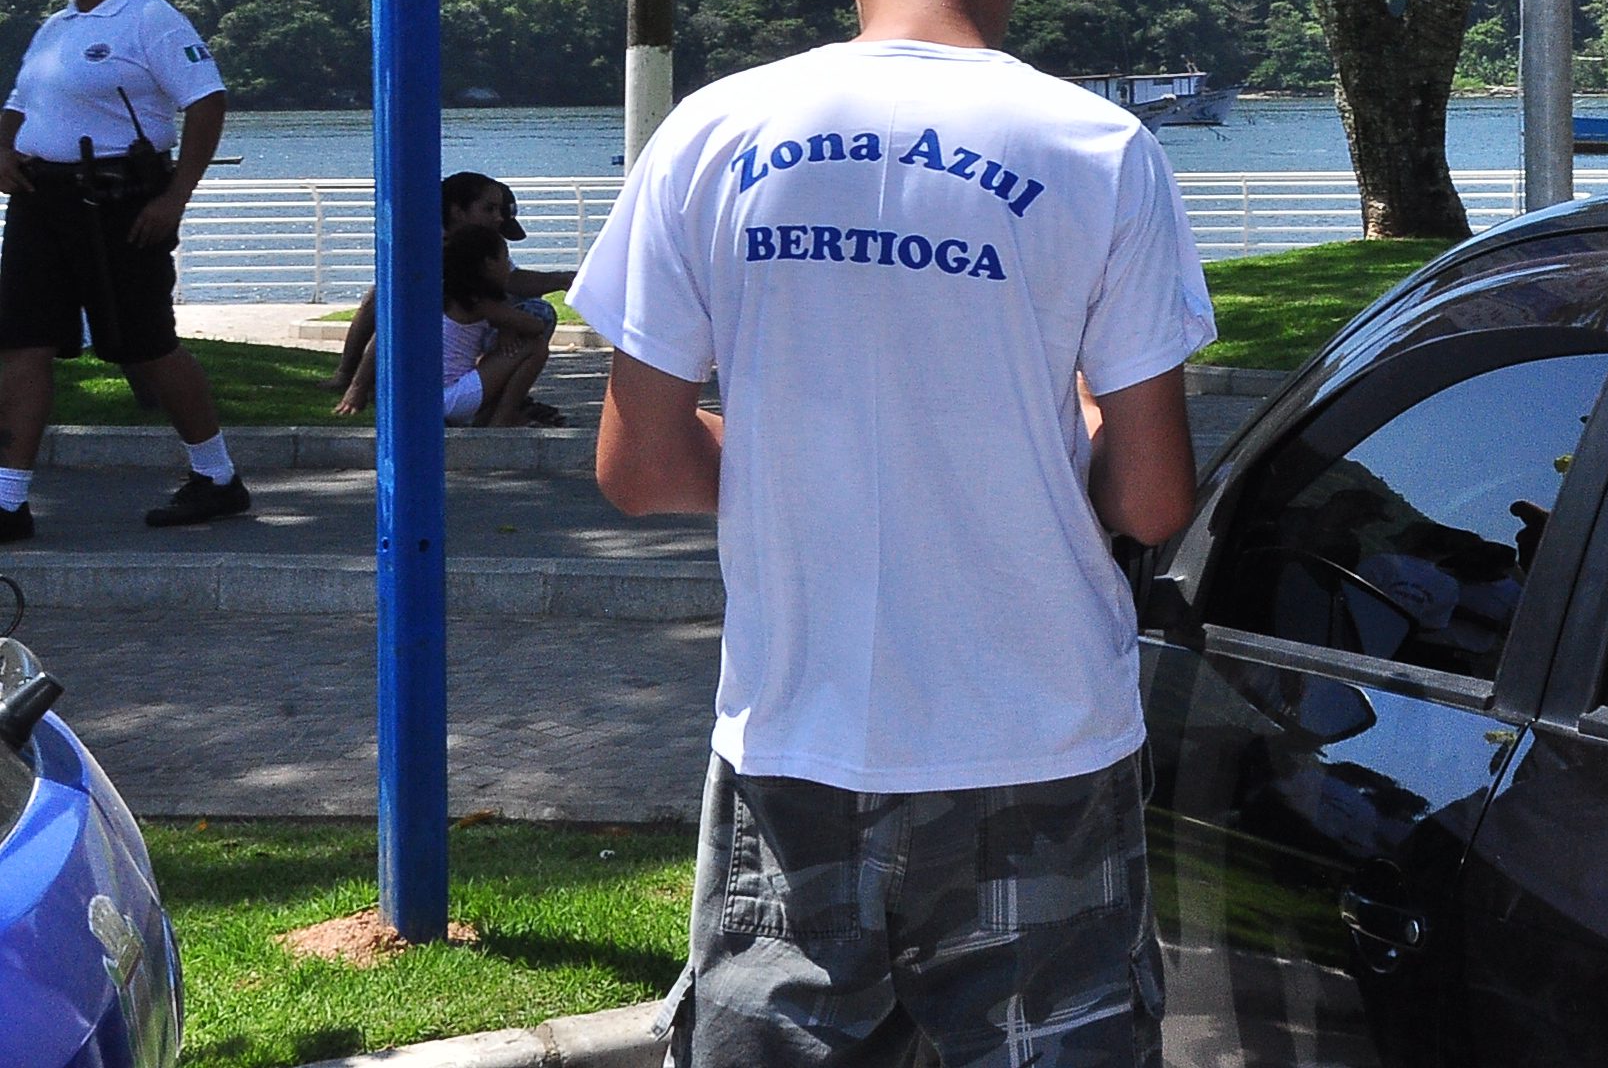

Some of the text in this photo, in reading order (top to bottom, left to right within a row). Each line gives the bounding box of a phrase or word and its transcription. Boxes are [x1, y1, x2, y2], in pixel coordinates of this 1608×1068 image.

[731, 128, 1045, 218] Zona Azul
[744, 224, 1008, 281] BERTIOGA
